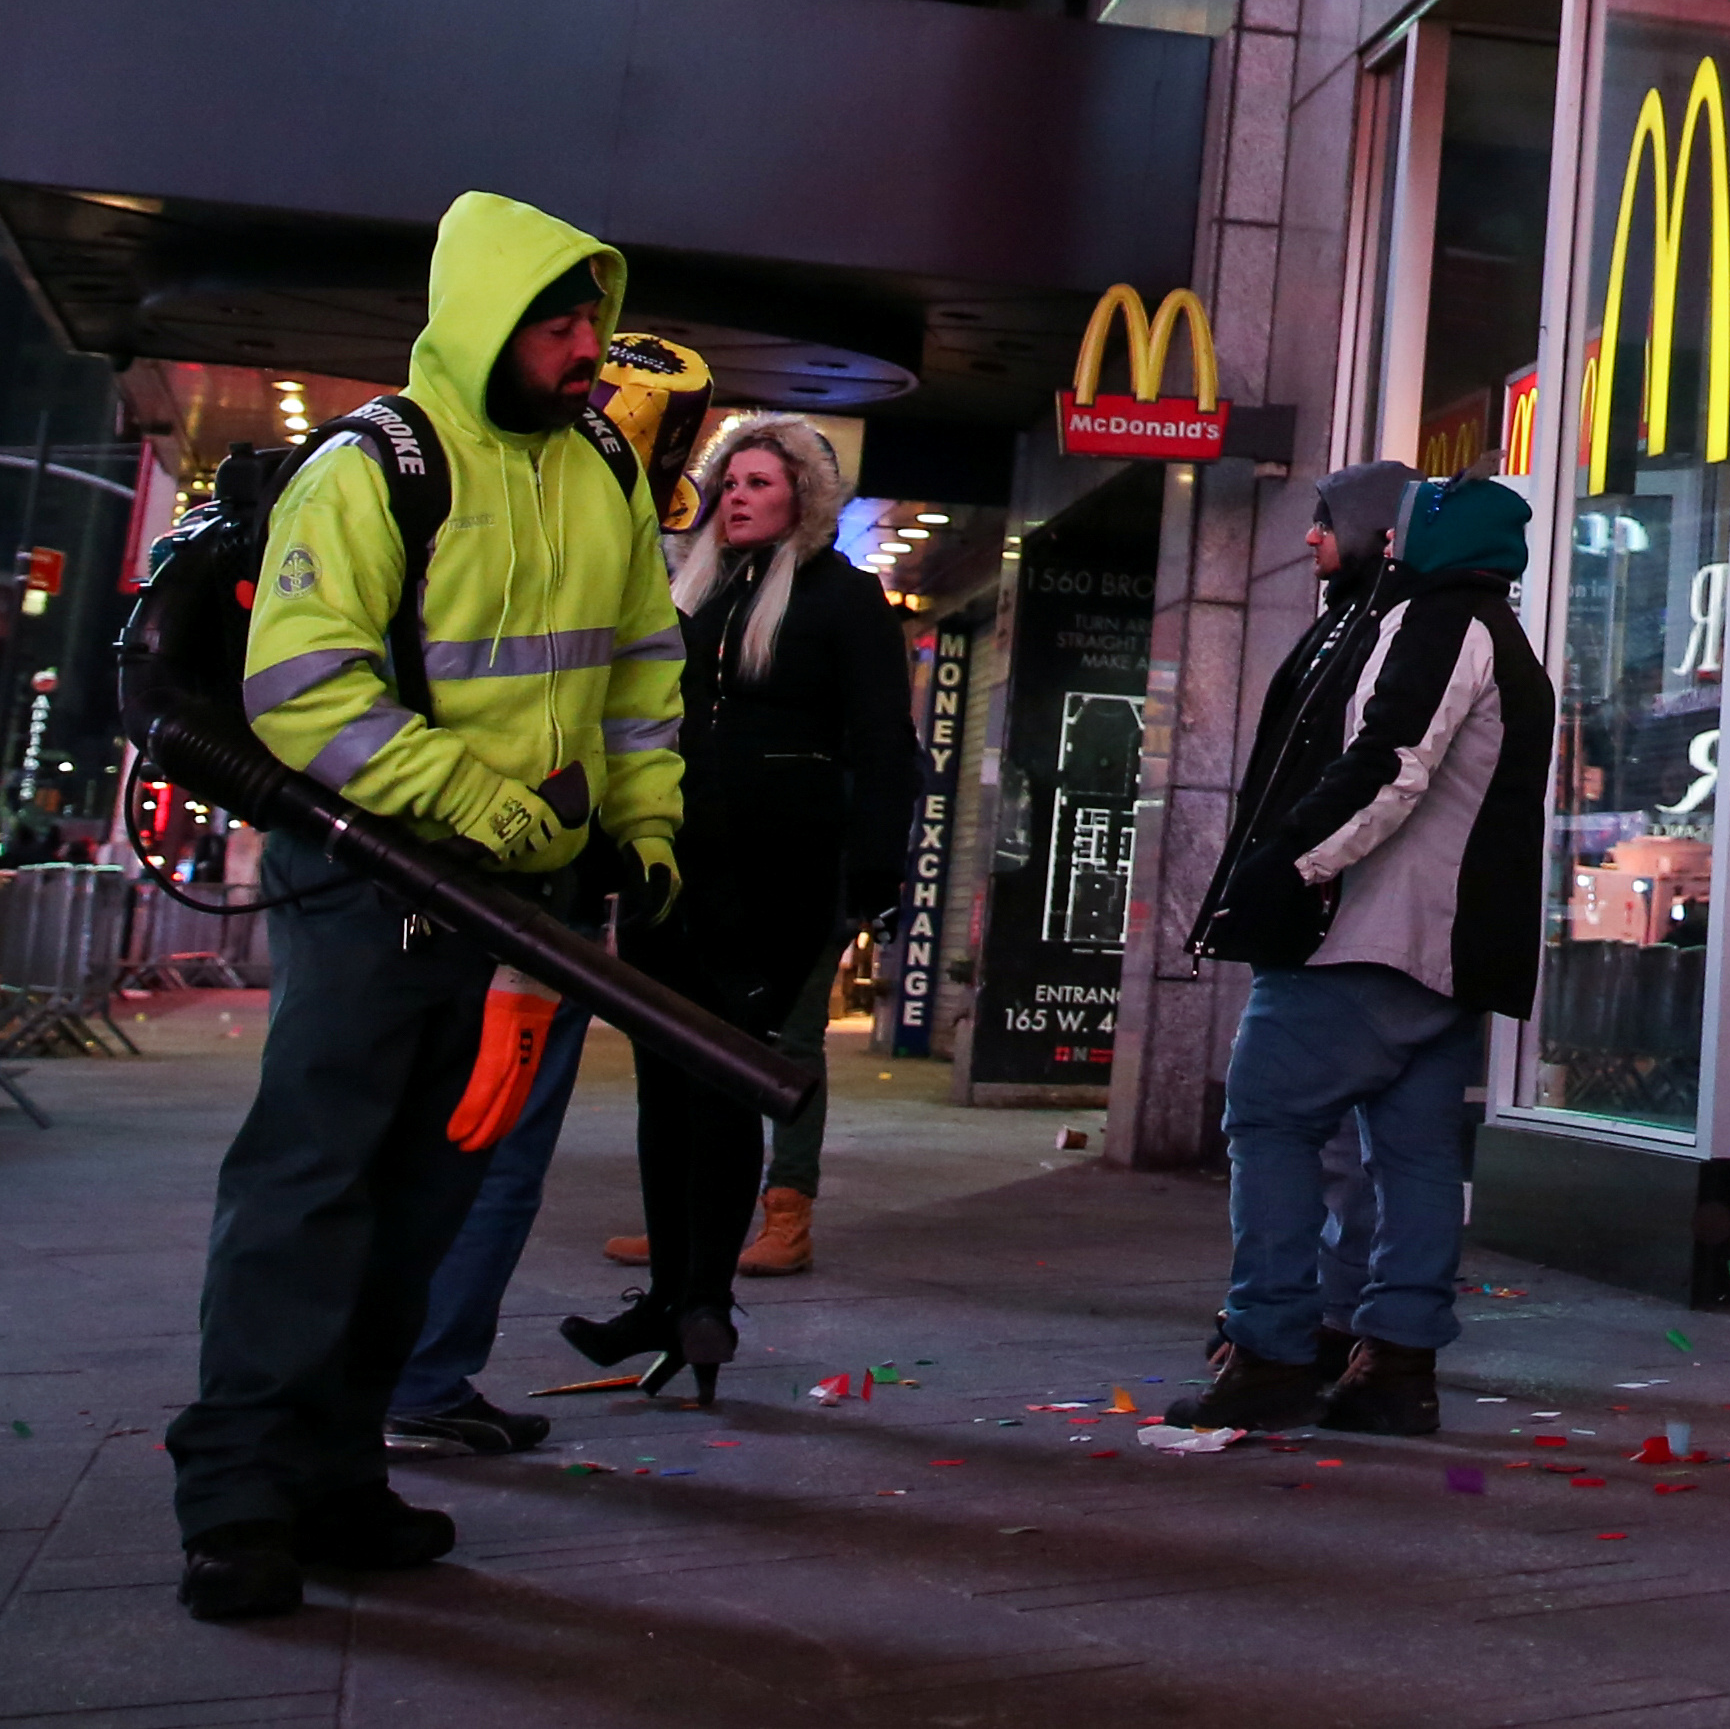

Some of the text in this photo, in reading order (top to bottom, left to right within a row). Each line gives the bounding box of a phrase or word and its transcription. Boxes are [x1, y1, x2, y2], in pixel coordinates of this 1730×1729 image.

[1069, 413, 1221, 440] McDonald's
[1026, 566, 1093, 595] 1560
[1056, 631, 1138, 653] STRAIGHT
[1079, 652, 1133, 671] MAKE
[903, 632, 965, 1027] MONEY EXCHANGE
[1003, 1007, 1048, 1033] 165
[1055, 1009, 1090, 1034] W.
